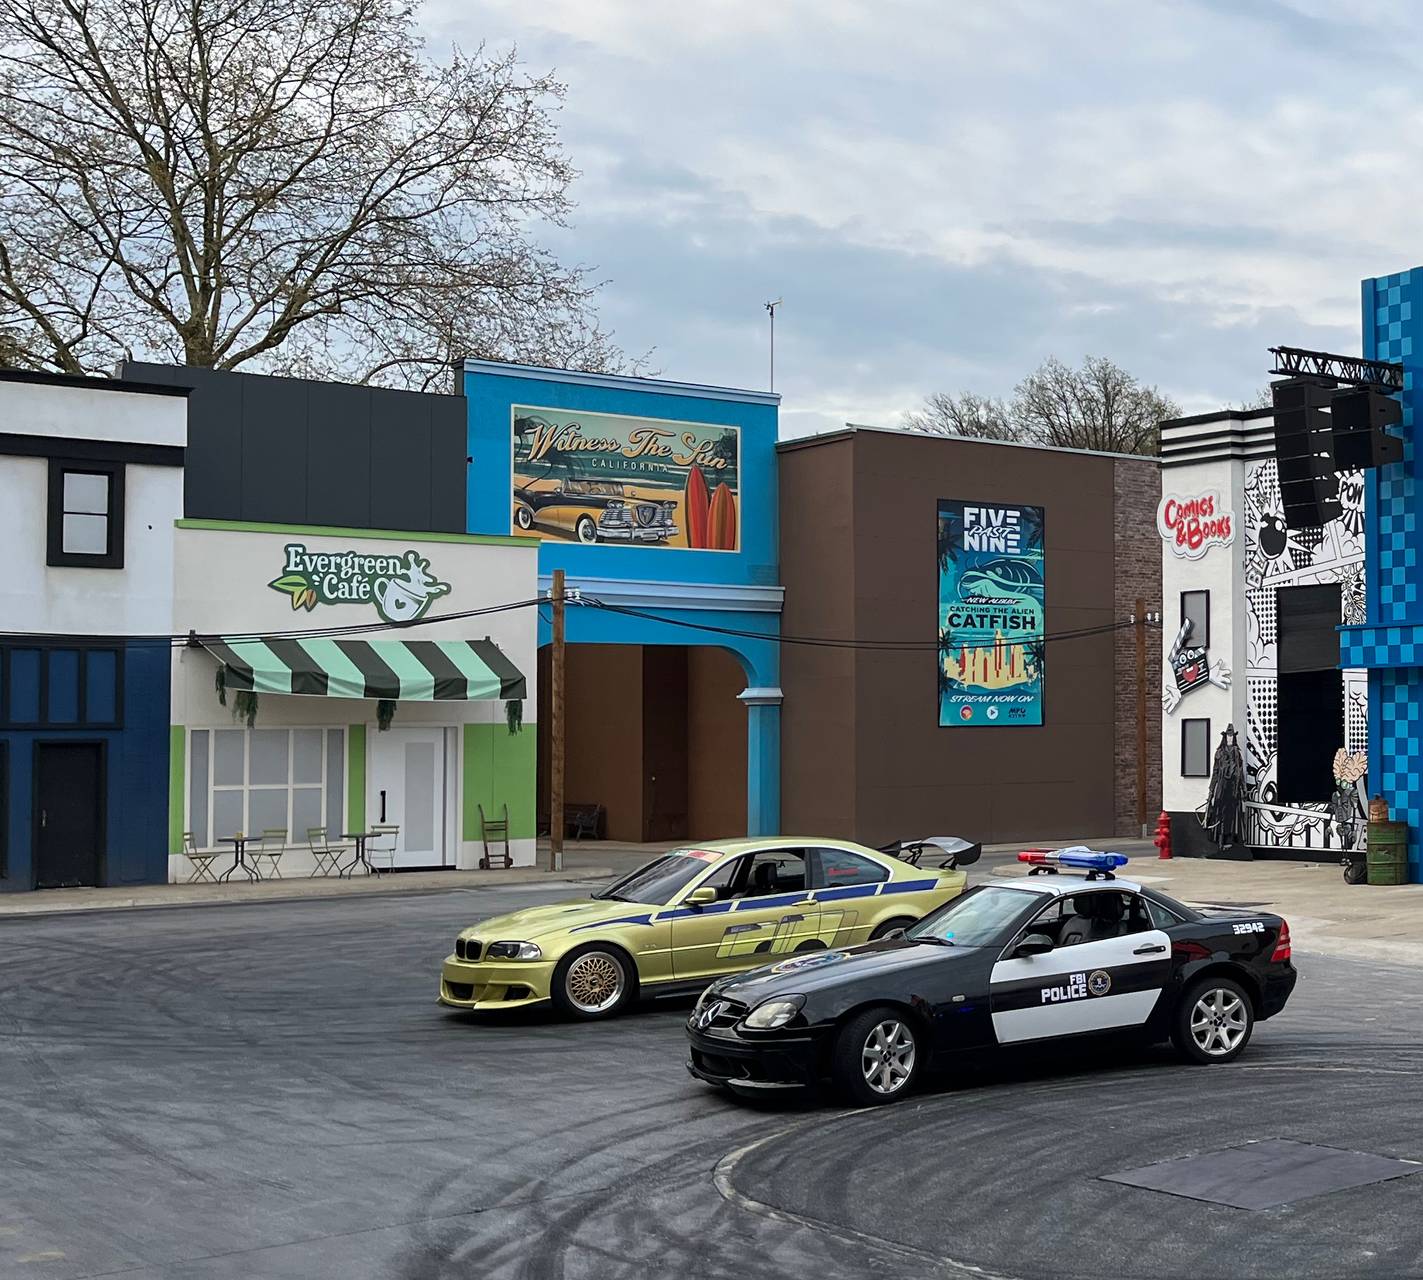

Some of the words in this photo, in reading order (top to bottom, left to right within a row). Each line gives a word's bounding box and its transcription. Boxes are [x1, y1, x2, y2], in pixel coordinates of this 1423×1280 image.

[524, 422, 622, 461] Witness
[600, 427, 676, 458] The
[672, 432, 728, 469] Sun
[591, 458, 669, 473] CALIFORNIA
[1339, 481, 1365, 505] POW
[963, 507, 1021, 531] FIVE
[969, 525, 1017, 539] PAST
[963, 531, 1021, 554] NINE
[286, 546, 402, 579] Evergreen
[322, 574, 371, 600] Café
[949, 605, 991, 614] CATCHING
[993, 606, 1008, 614] THE
[1011, 607, 1035, 616] ALIEN
[947, 613, 1036, 630] CATFISH
[950, 694, 992, 703] STREAM
[992, 695, 1018, 703] NOW
[1017, 695, 1035, 703] ON
[1232, 921, 1265, 935] 32942
[1069, 972, 1087, 985] FBI
[1040, 984, 1088, 1003] POLICE
